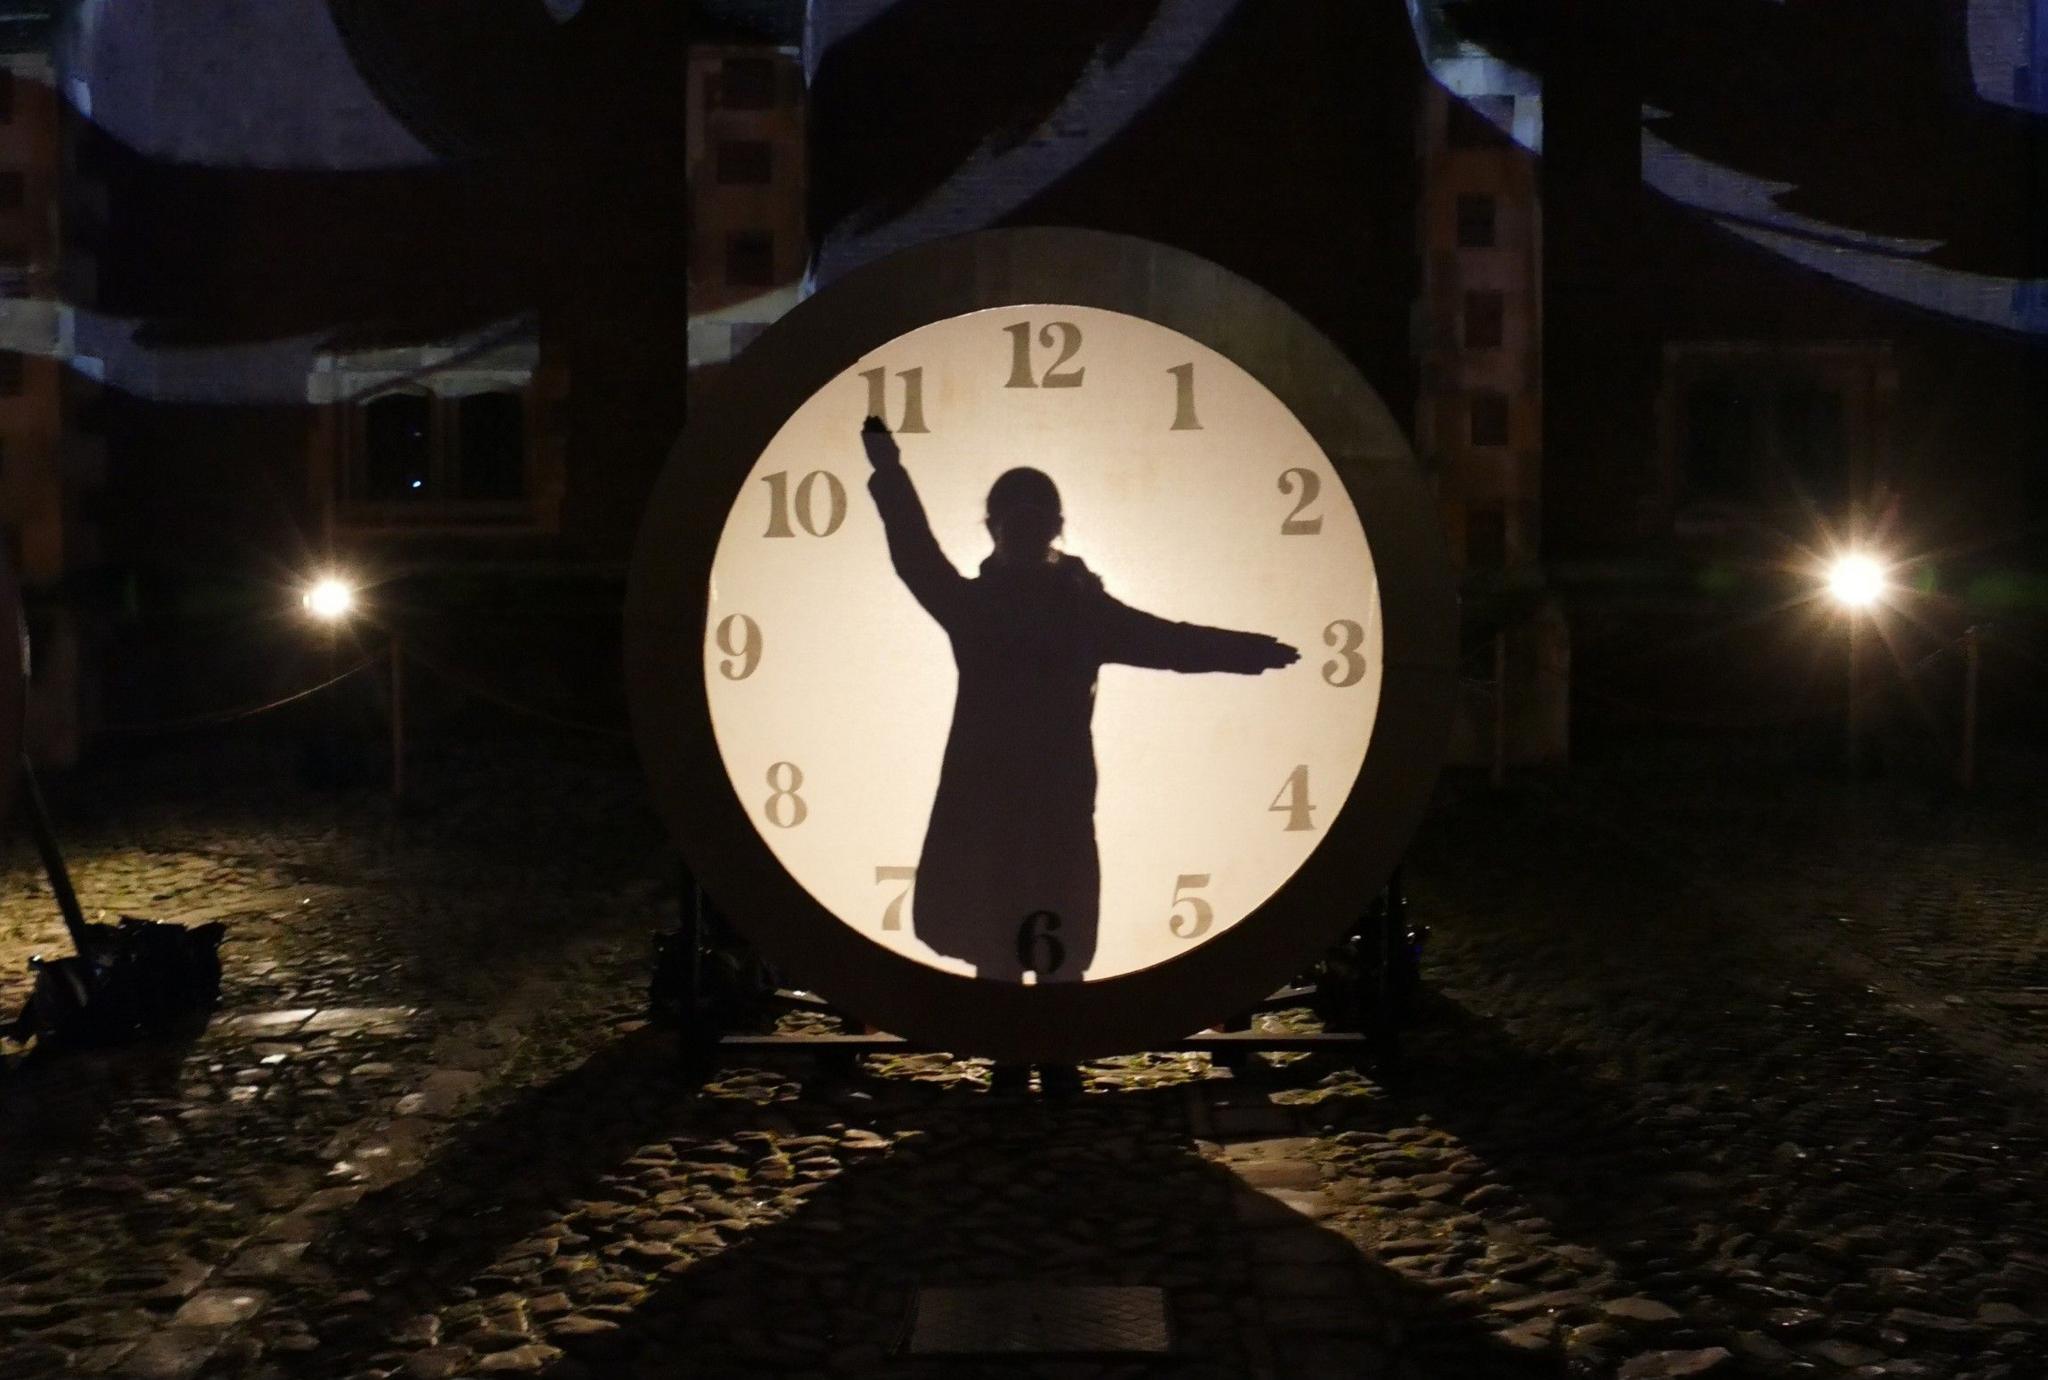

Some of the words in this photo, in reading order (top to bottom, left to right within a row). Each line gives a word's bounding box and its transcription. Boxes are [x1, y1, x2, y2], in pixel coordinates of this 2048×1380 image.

[1003, 321, 1086, 388] 12
[858, 366, 931, 433] 11
[1166, 362, 1204, 430] 1
[761, 470, 848, 538] 10
[1277, 467, 1324, 535] 2
[716, 613, 763, 680] 9
[1321, 619, 1366, 687] 3
[764, 761, 808, 828] 8
[1269, 765, 1316, 831] 4
[875, 866, 916, 931] 7
[1169, 874, 1213, 939] 5
[1017, 910, 1065, 974] 6
